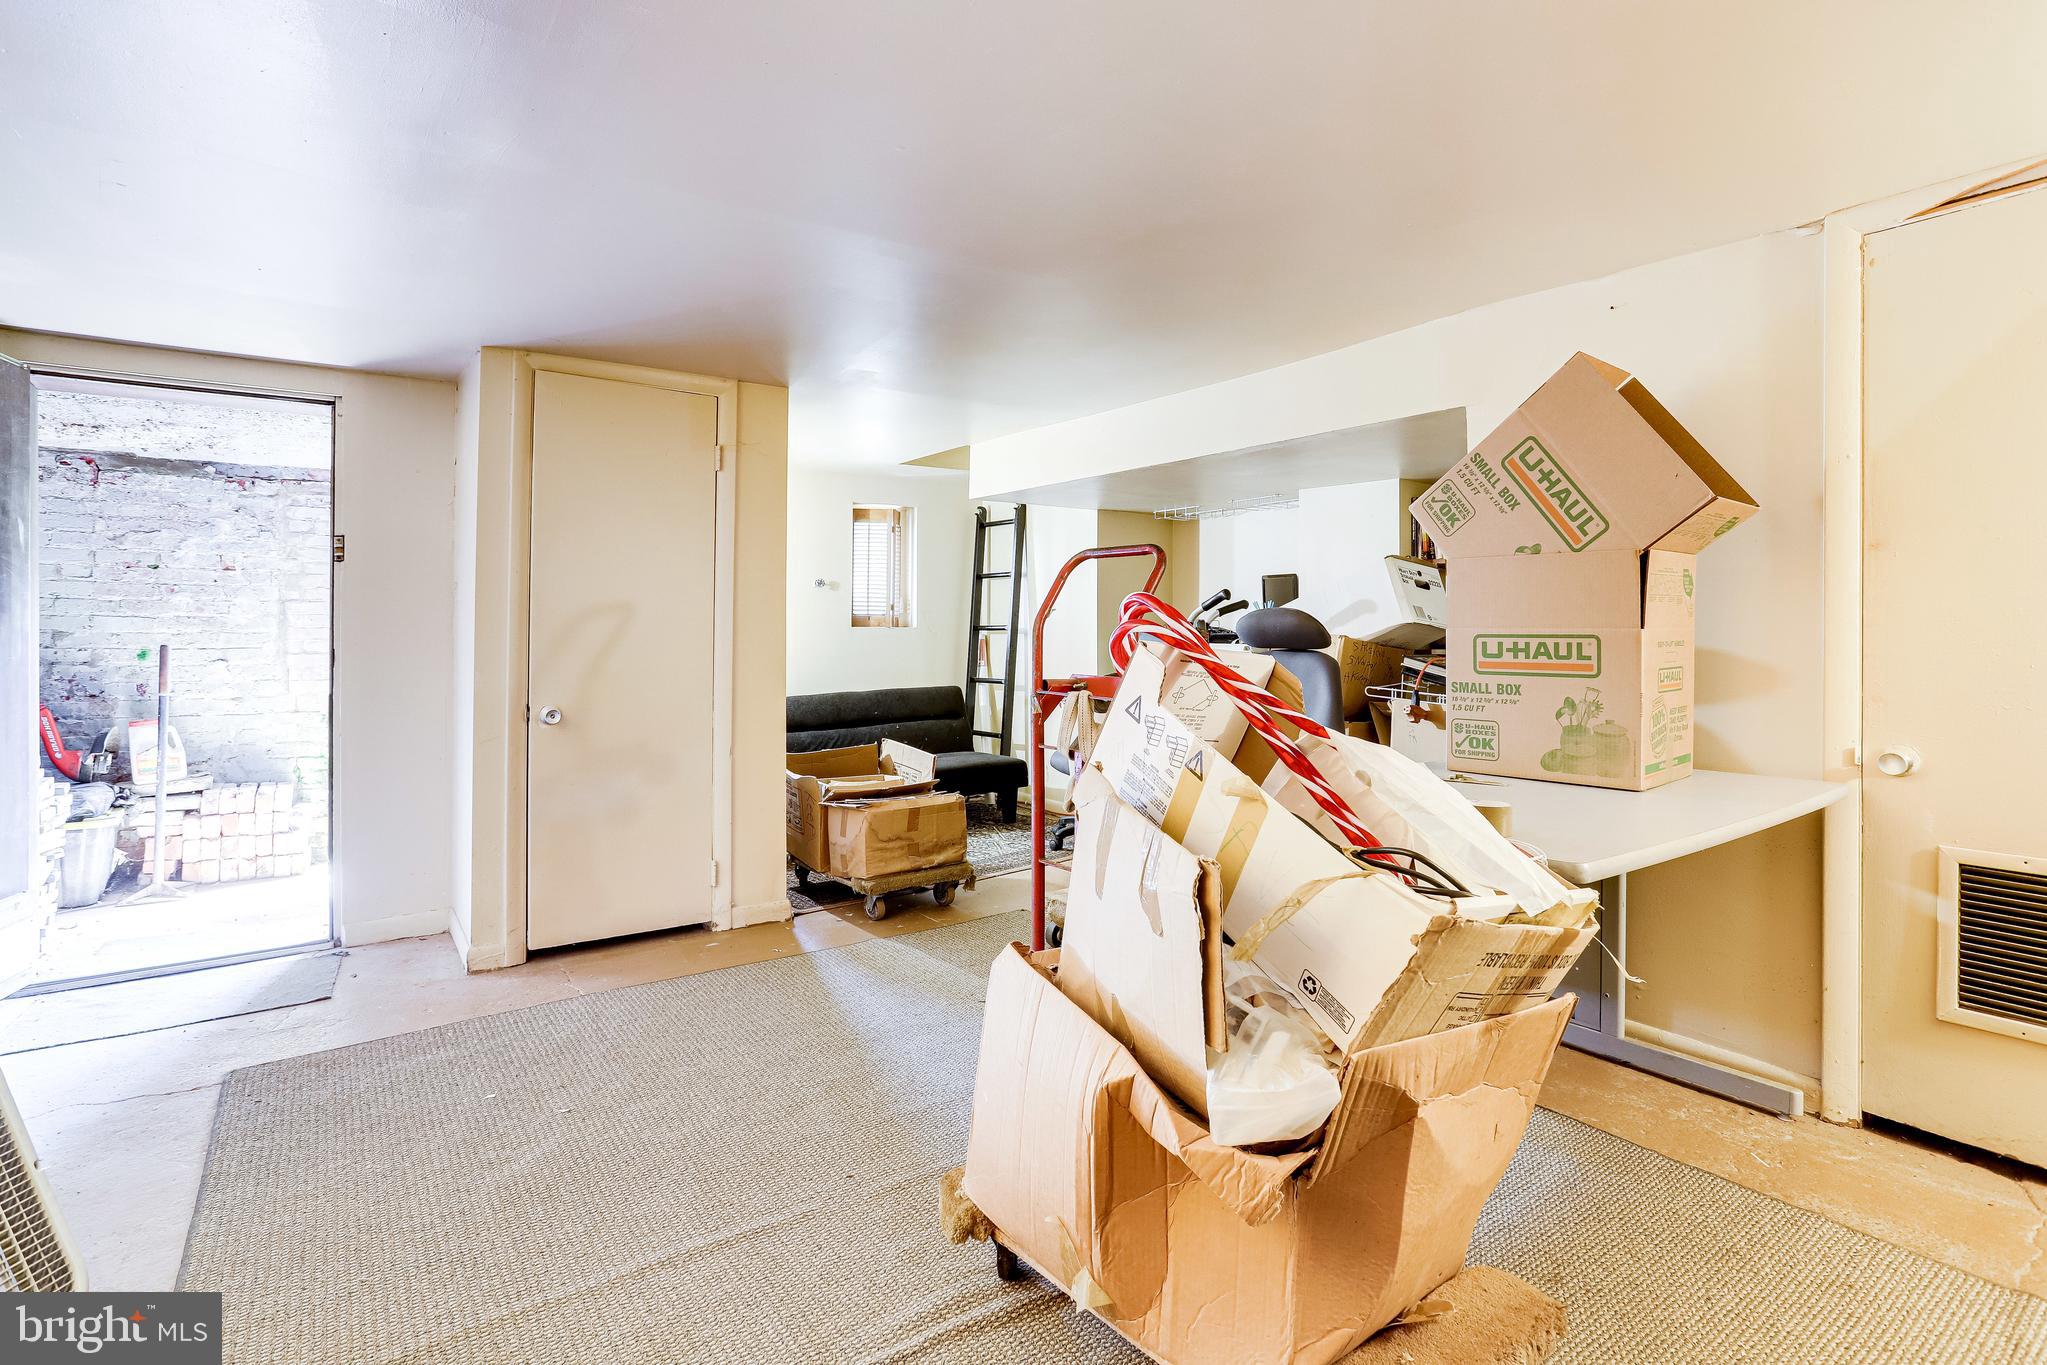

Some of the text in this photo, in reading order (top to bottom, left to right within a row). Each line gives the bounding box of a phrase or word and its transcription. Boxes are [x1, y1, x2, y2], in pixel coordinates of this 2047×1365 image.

[1456, 469, 1481, 495] 1.5 CU FT
[1470, 452, 1521, 511] SMALL BOX
[1425, 500, 1451, 533] FOR SHIPPING
[1439, 503, 1461, 528] OK
[1447, 495, 1468, 520] BOXES
[1451, 491, 1471, 517] U-HAUL
[1451, 681, 1522, 696] SMALL BOX
[1465, 723, 1496, 731] U-HAUL
[1465, 729, 1497, 737] BOXES
[1468, 736, 1495, 751] OK
[1468, 749, 1496, 757] SHIPPING
